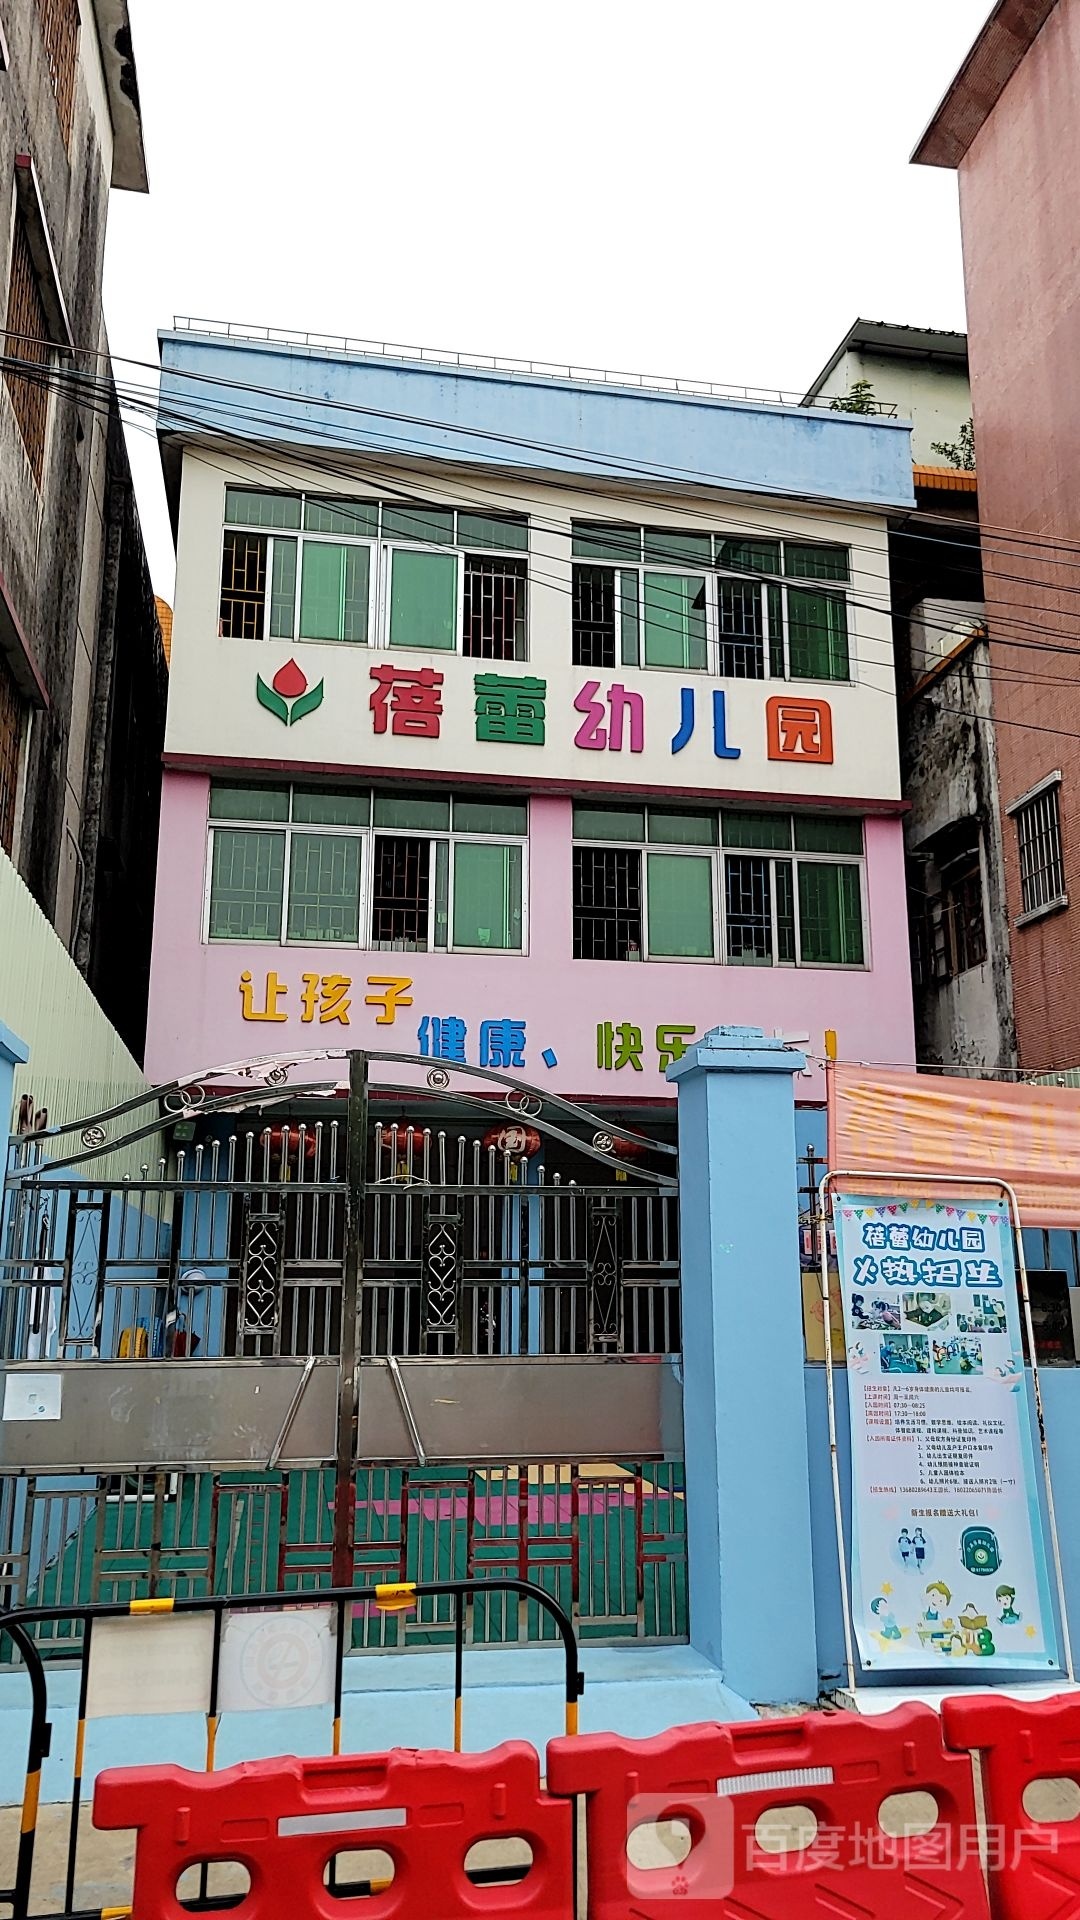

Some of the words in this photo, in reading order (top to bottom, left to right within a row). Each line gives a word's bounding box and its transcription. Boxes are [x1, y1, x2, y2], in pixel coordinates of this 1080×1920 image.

[369, 664, 834, 764] 蓓蕾幼儿园
[240, 969, 414, 1025] 让孩子
[863, 1223, 984, 1252] 蓓蕾幼儿园
[853, 1255, 1002, 1288] 火热招生
